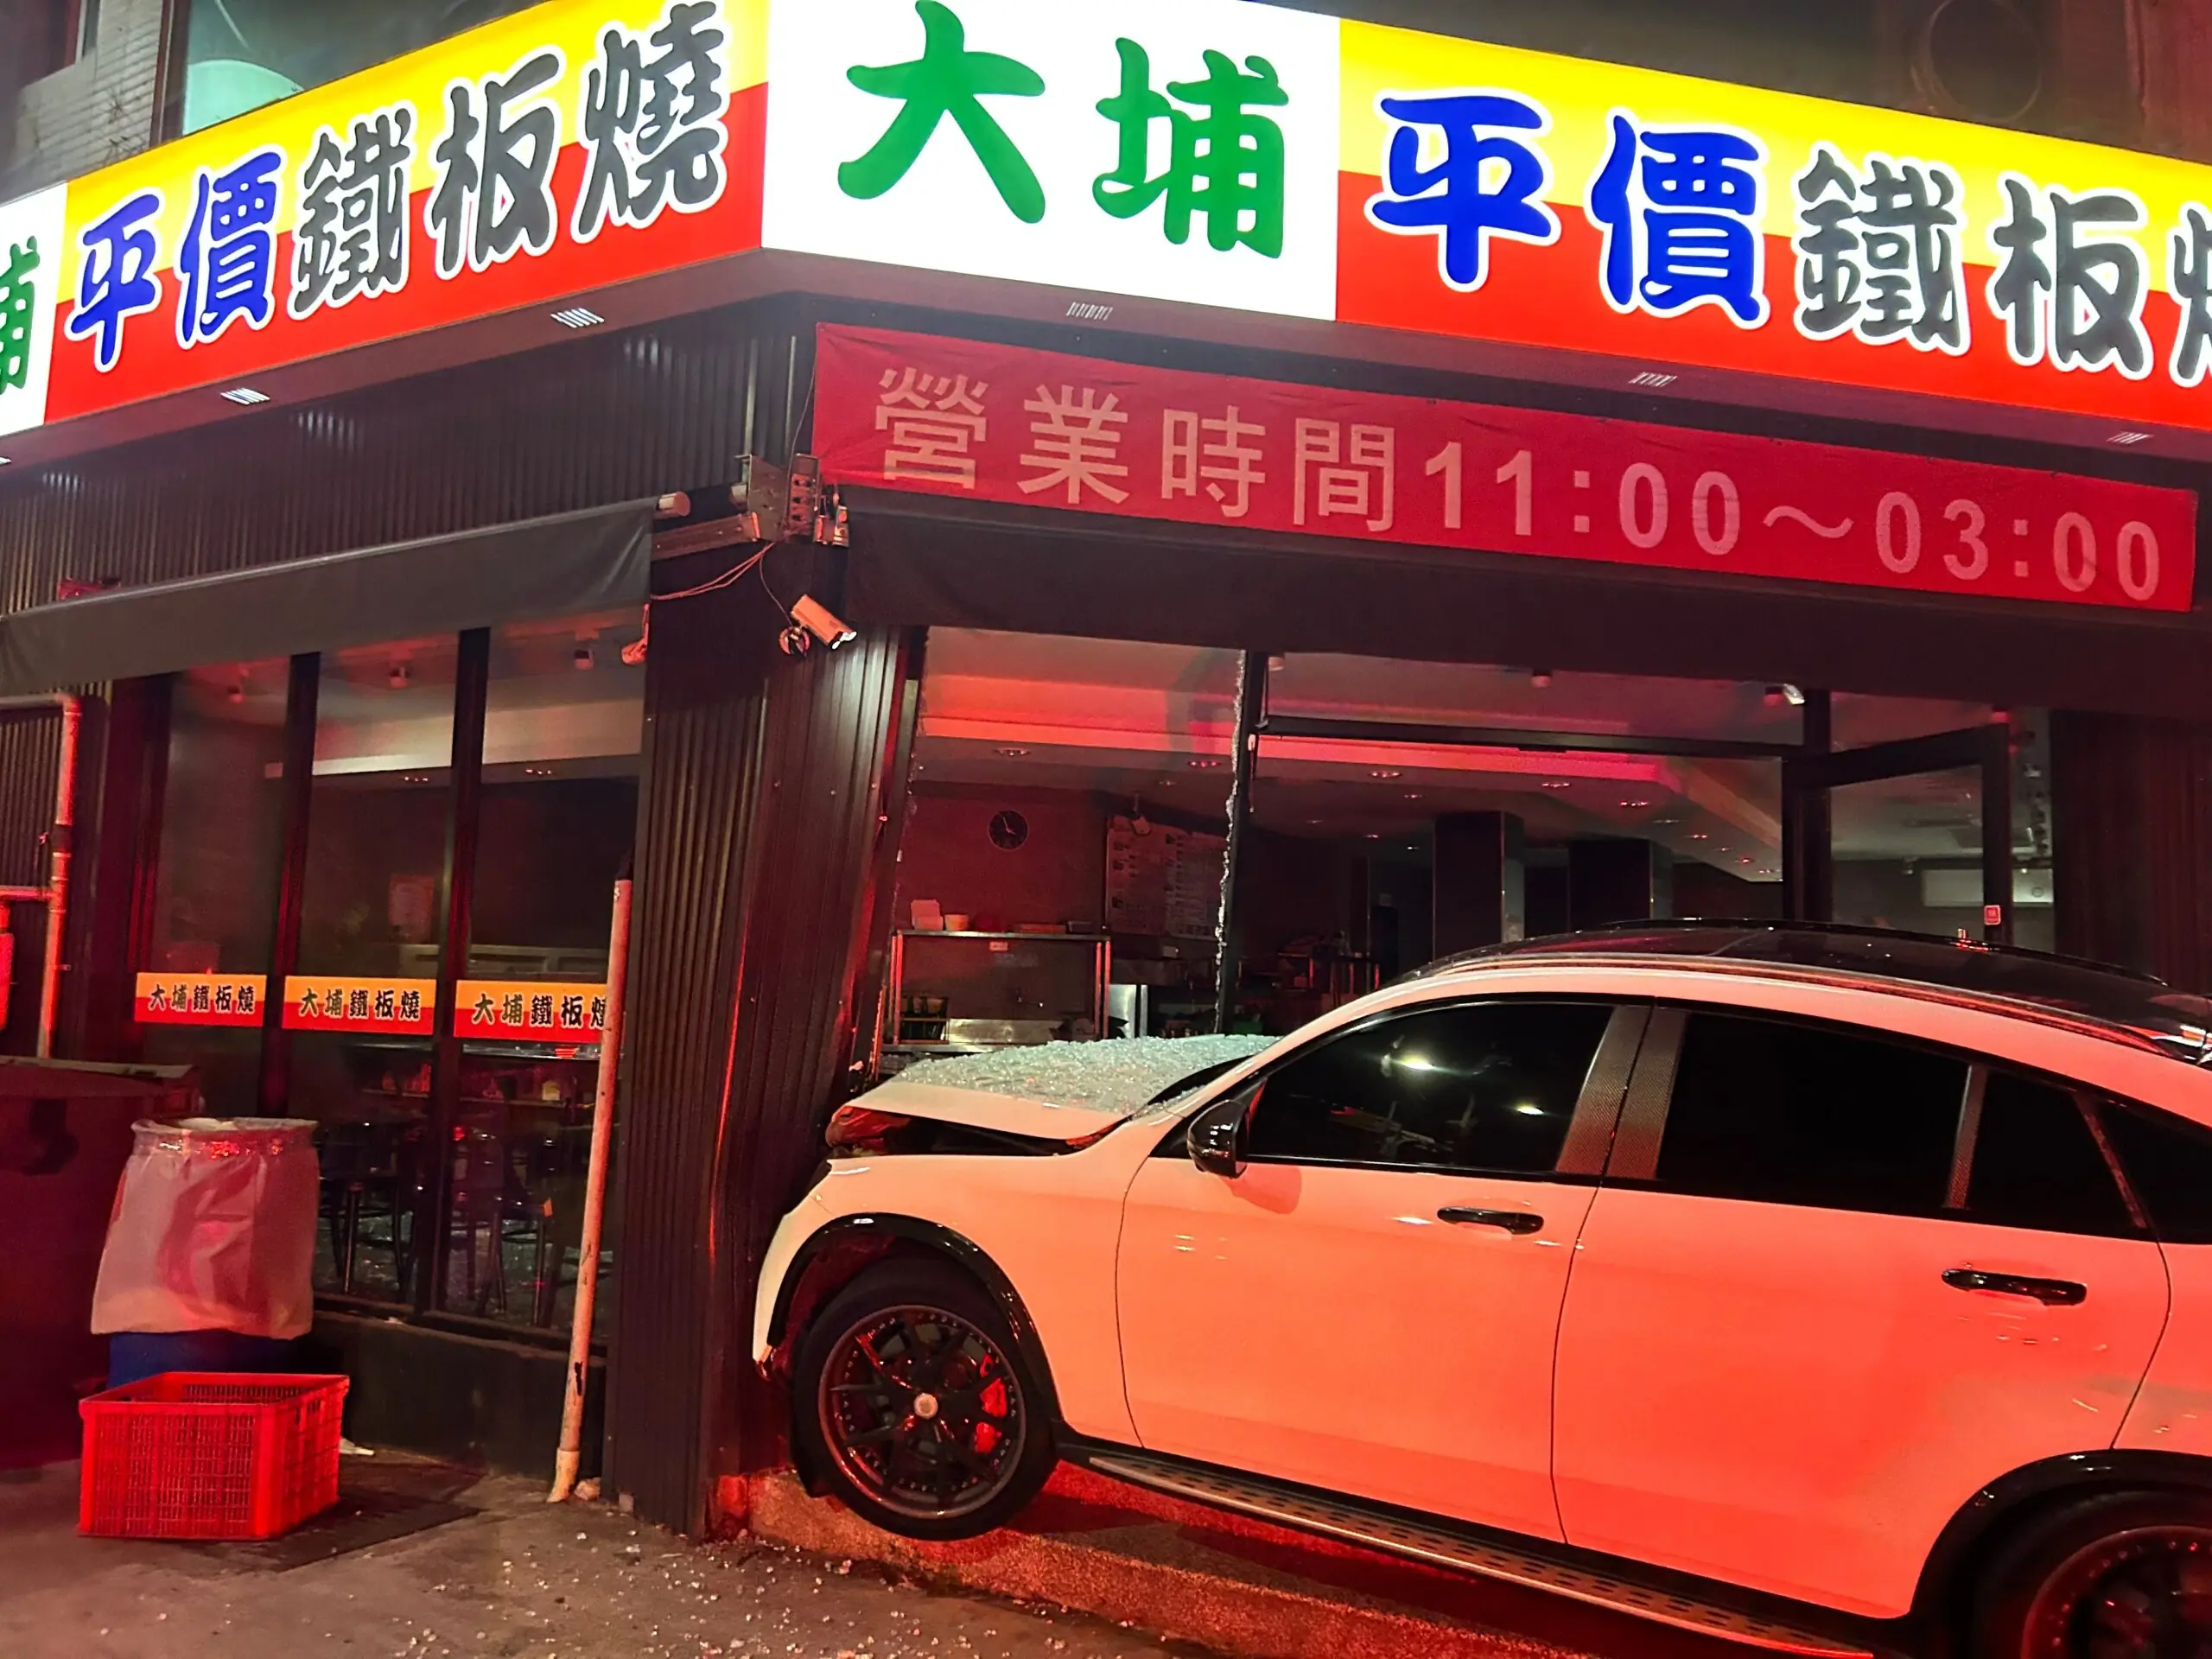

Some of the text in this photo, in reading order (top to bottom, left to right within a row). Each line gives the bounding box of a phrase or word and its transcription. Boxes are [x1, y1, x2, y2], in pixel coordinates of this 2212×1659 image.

[72, 1, 724, 365] 平價鐵板燒
[837, 0, 1289, 259] 大埔
[149, 983, 255, 1014] 大埔鐵板燒
[299, 988, 421, 1020] 大埔鐵板燒
